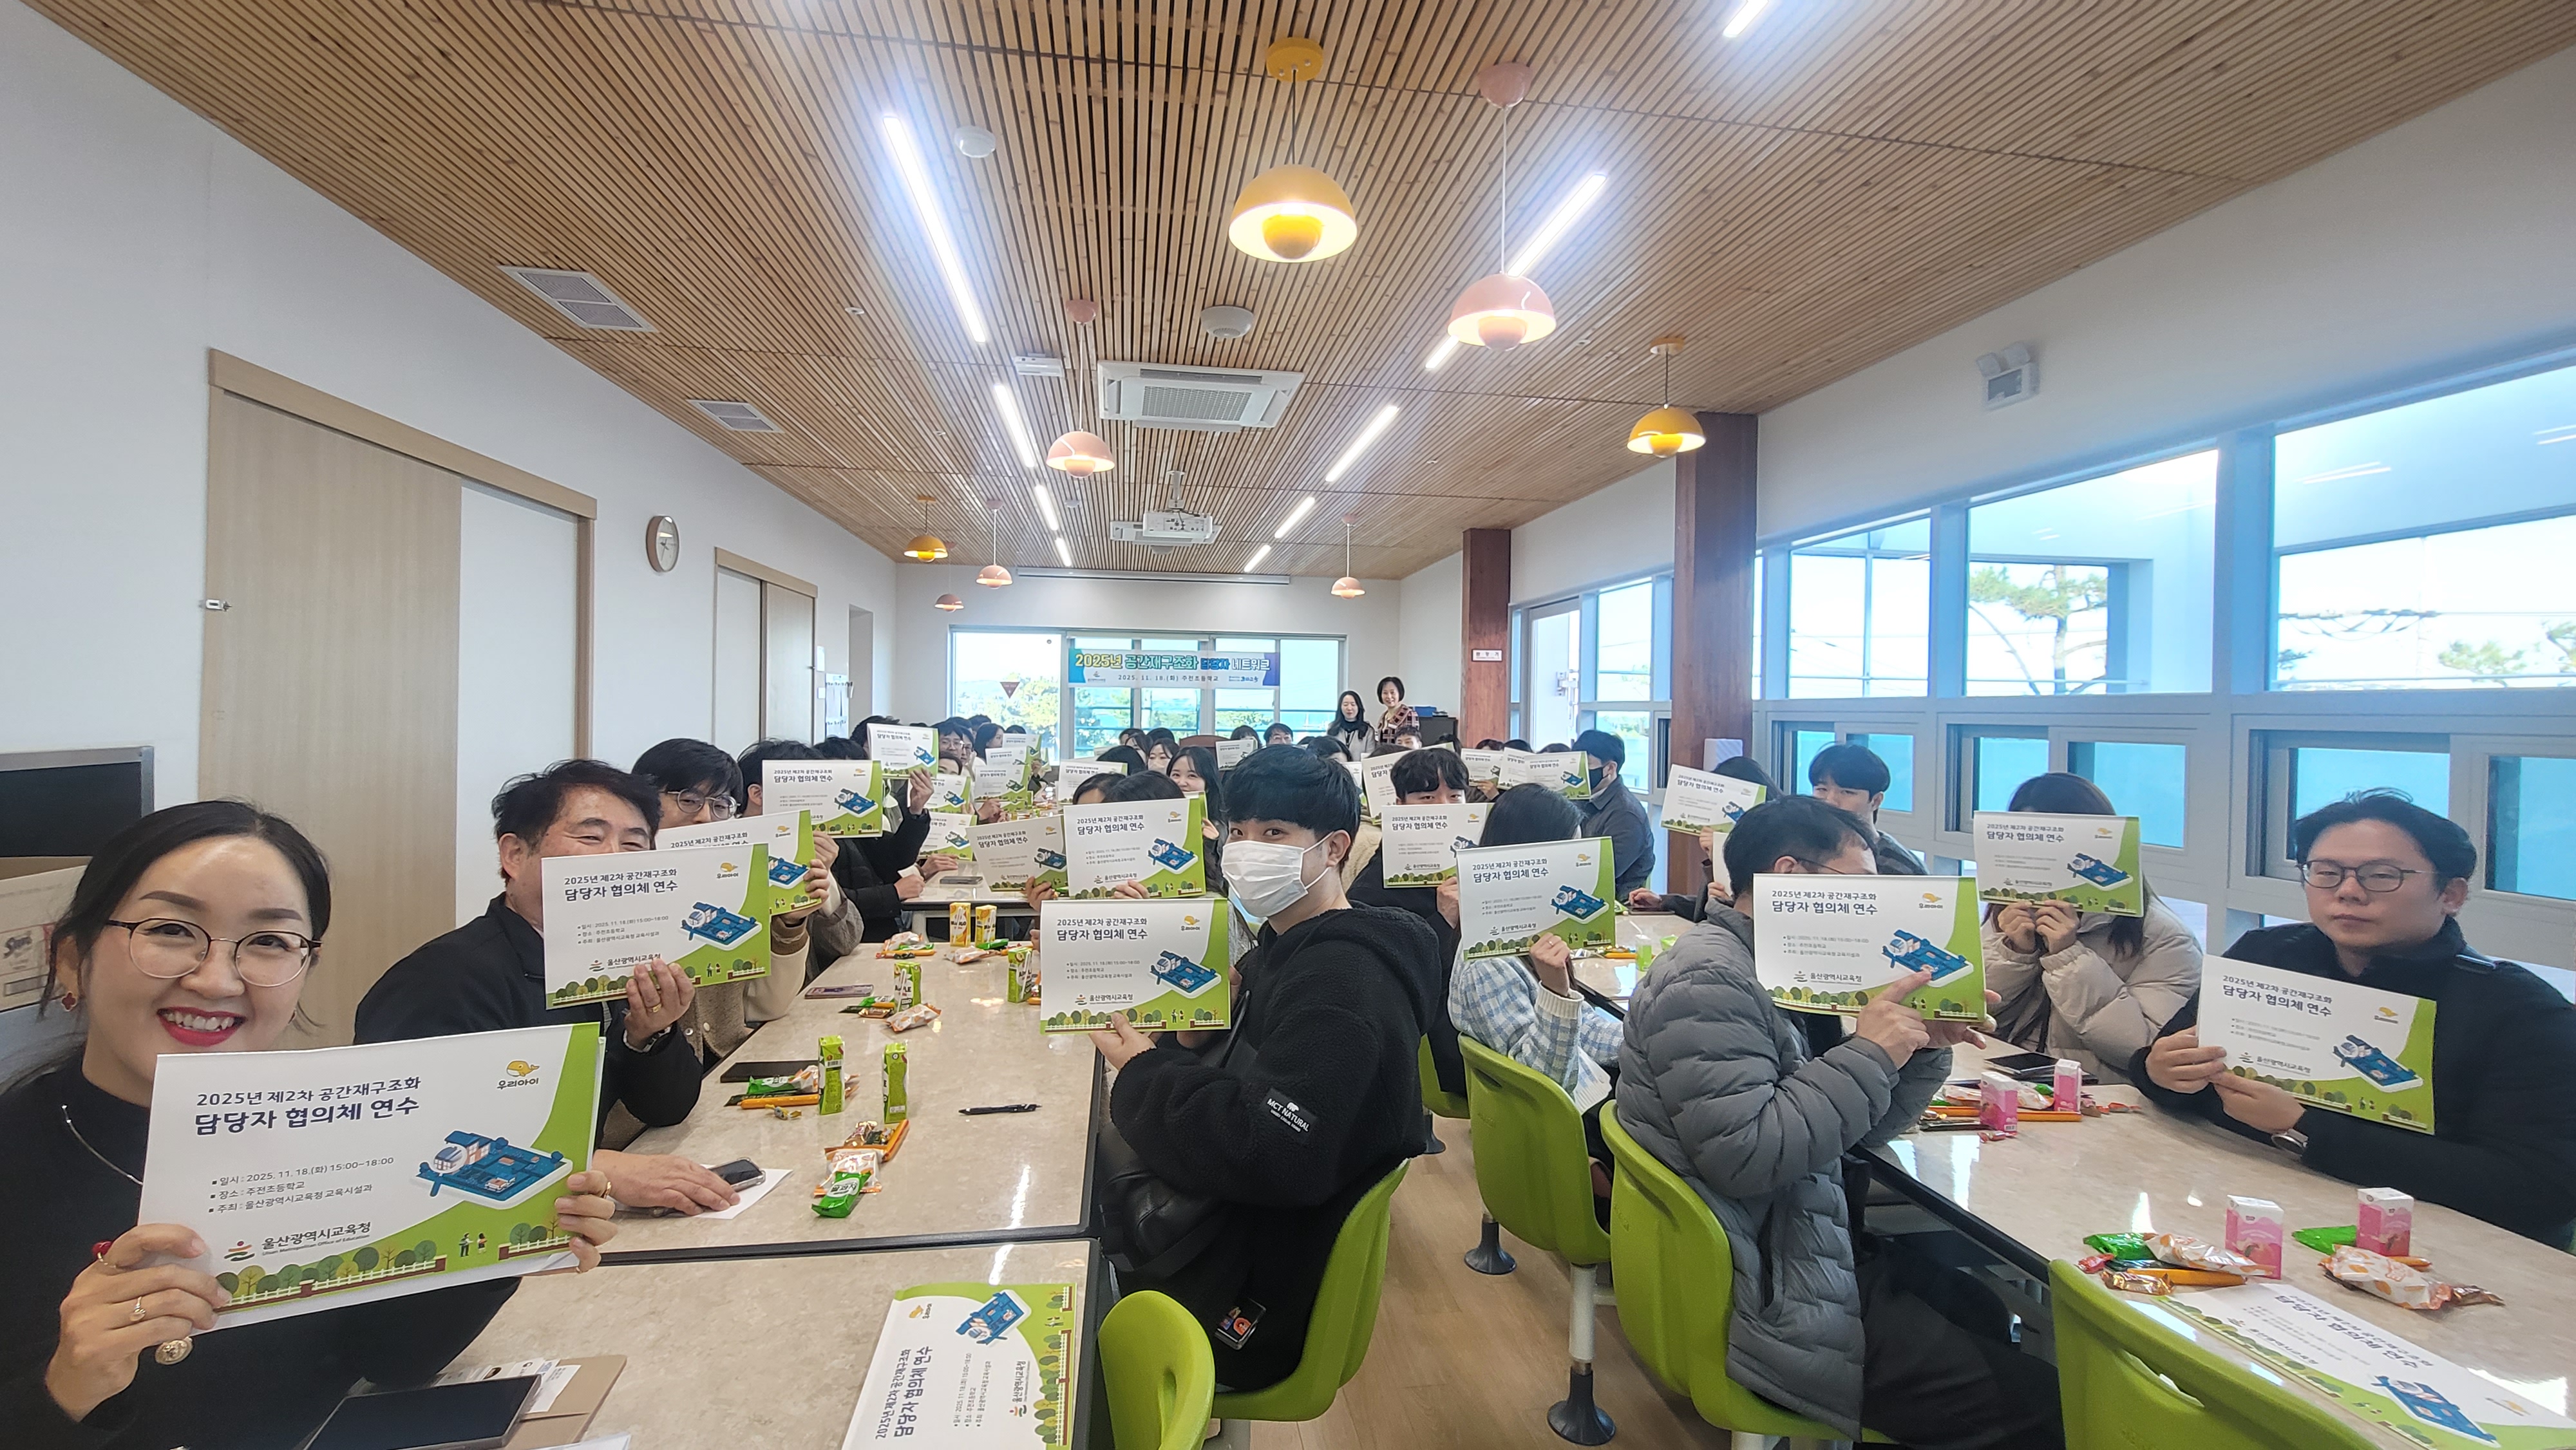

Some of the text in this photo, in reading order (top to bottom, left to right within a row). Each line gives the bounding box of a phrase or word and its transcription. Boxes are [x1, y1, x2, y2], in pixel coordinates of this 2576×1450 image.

[1075, 654, 1271, 670] 2025년 공간재구조화 담당자 네트워크
[1077, 822, 1144, 835] 담당자 협의체 연수
[1987, 831, 2065, 843] 담당자 협의체 연수
[670, 838, 694, 849] 2025년
[695, 836, 712, 845] 제2차
[713, 832, 748, 842] 공간재구조화
[1513, 858, 1548, 867] 공간재구조화
[564, 869, 677, 885] 2025년 제2차 공간재구조화
[1473, 867, 1549, 883] 담당자 협의체 연수
[565, 880, 678, 901] 담당자 협의체 연수
[1828, 892, 1877, 901] 공간재구조화
[1772, 901, 1878, 915] 담당자 협의체 연수
[1057, 928, 1148, 941] 담당자 협의체 연수
[1810, 973, 1862, 982] 울산광역시교육청
[2223, 975, 2333, 1004] 2025년 제2차 공간재구조화
[2223, 984, 2332, 1017] 담당자 협의체 연수
[196, 1076, 421, 1106] 2025년 제2차 공간재구조화
[497, 1078, 538, 1089] 우리아이
[195, 1097, 419, 1135] 담당자 협의체 연수
[1267, 1098, 1310, 1132] MCT NATURAL
[247, 1172, 276, 1182] 2025.
[330, 1157, 394, 1171] 15:00~18:00
[245, 1191, 323, 1210] 울산광역시교육청
[325, 1183, 372, 1198] 교육시설과
[246, 1182, 305, 1196] 주전초등학교
[261, 1221, 371, 1250] 울산광역시교육청
[1012, 1361, 1027, 1403] 울산광역시교육청
[876, 1349, 911, 1440] 2025년 제2차 공간재구조화
[893, 1346, 933, 1437] 담당자 협의체 연수
